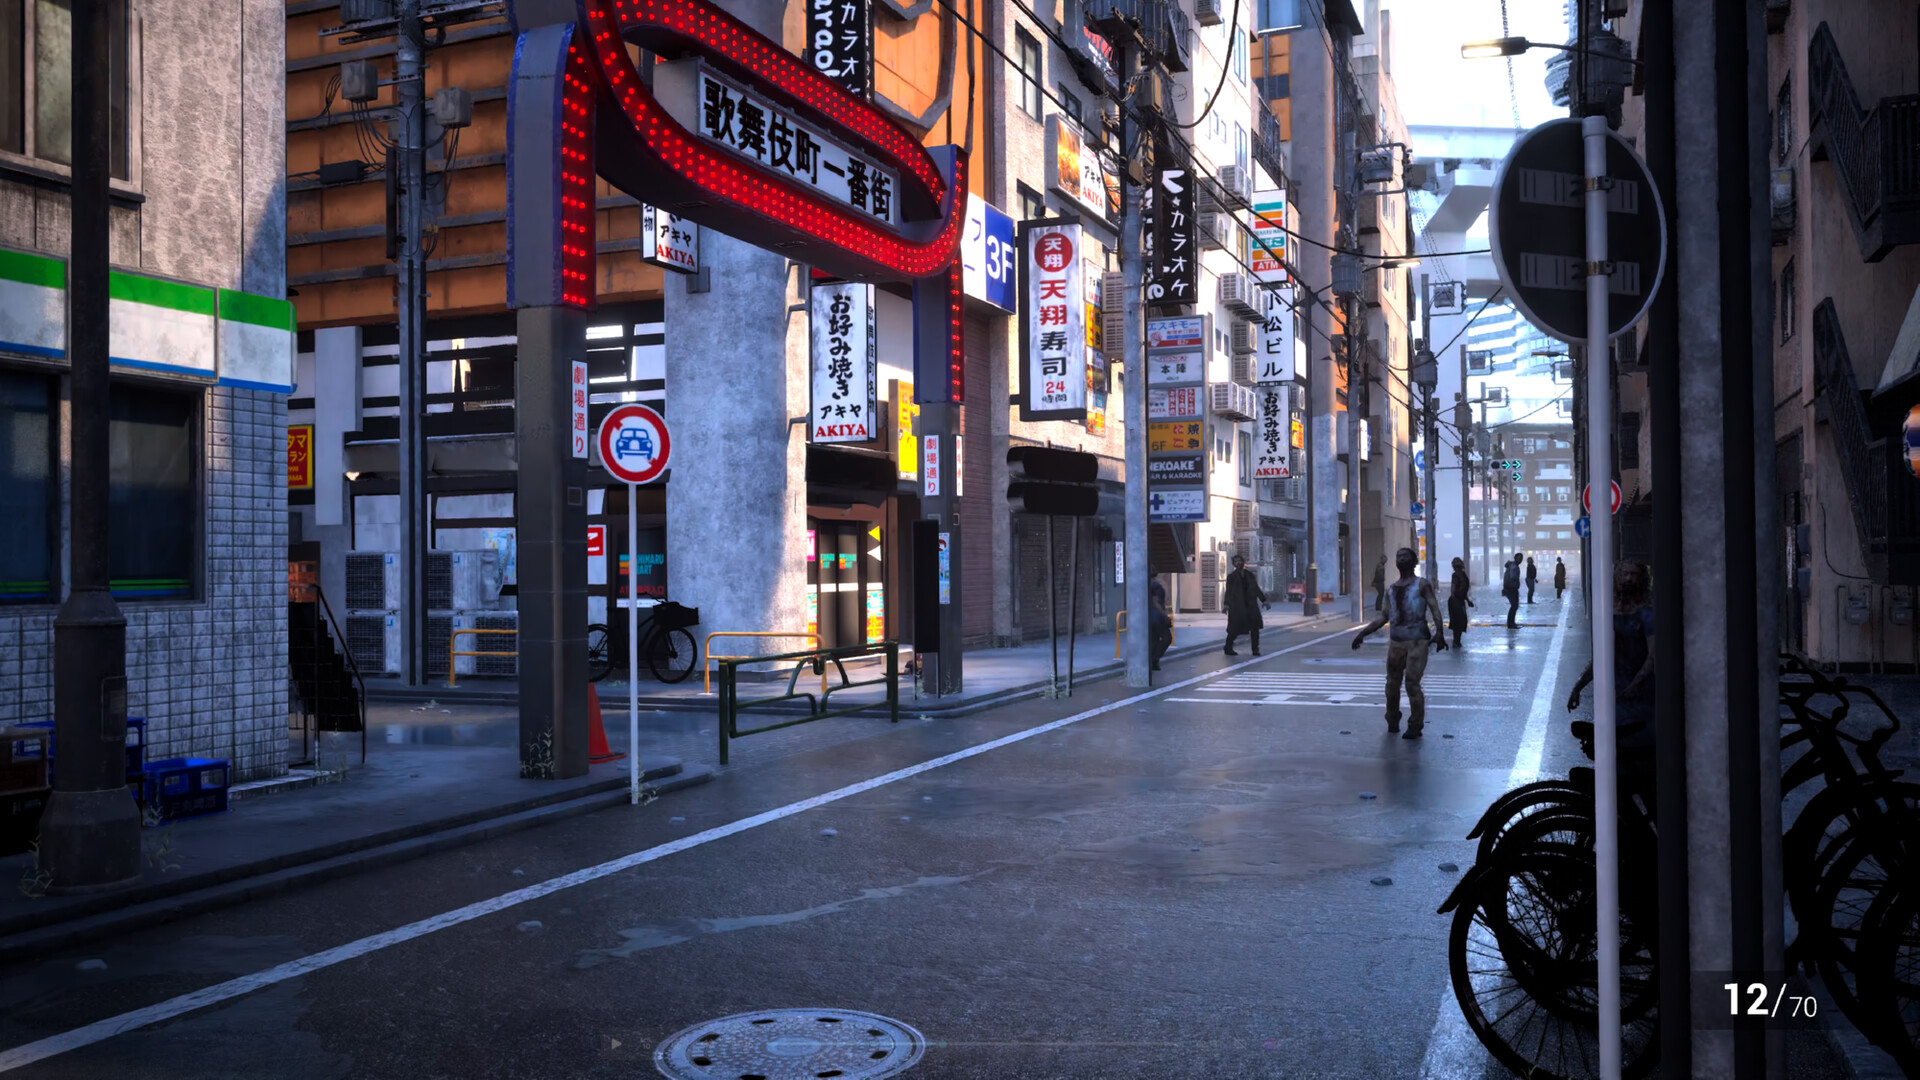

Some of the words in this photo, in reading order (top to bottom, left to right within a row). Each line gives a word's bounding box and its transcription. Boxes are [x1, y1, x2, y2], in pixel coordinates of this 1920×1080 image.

[704, 77, 892, 222] 歌舞伎町一番街
[1082, 185, 1103, 209] AKIYA
[660, 224, 692, 248] アキヤ
[656, 243, 696, 268] AKIYA
[986, 234, 1014, 284] 3F
[1044, 238, 1063, 268] 天翔
[1171, 210, 1189, 297] カラオケ
[1257, 260, 1279, 271] ATM
[1039, 279, 1068, 377] 天翔寿司
[1257, 293, 1283, 378] 小松ビル
[828, 293, 854, 400] お好み焼き
[1045, 381, 1066, 394] 24
[573, 365, 586, 454] 劇場通り
[820, 403, 862, 420] アキヤ
[1263, 392, 1280, 454] お好み焼き
[814, 424, 867, 438] AKIYA
[1151, 441, 1167, 452] 6F
[1258, 455, 1286, 465] アキヤ
[925, 438, 938, 494] 劇場通り
[1255, 467, 1289, 476] AKIYA
